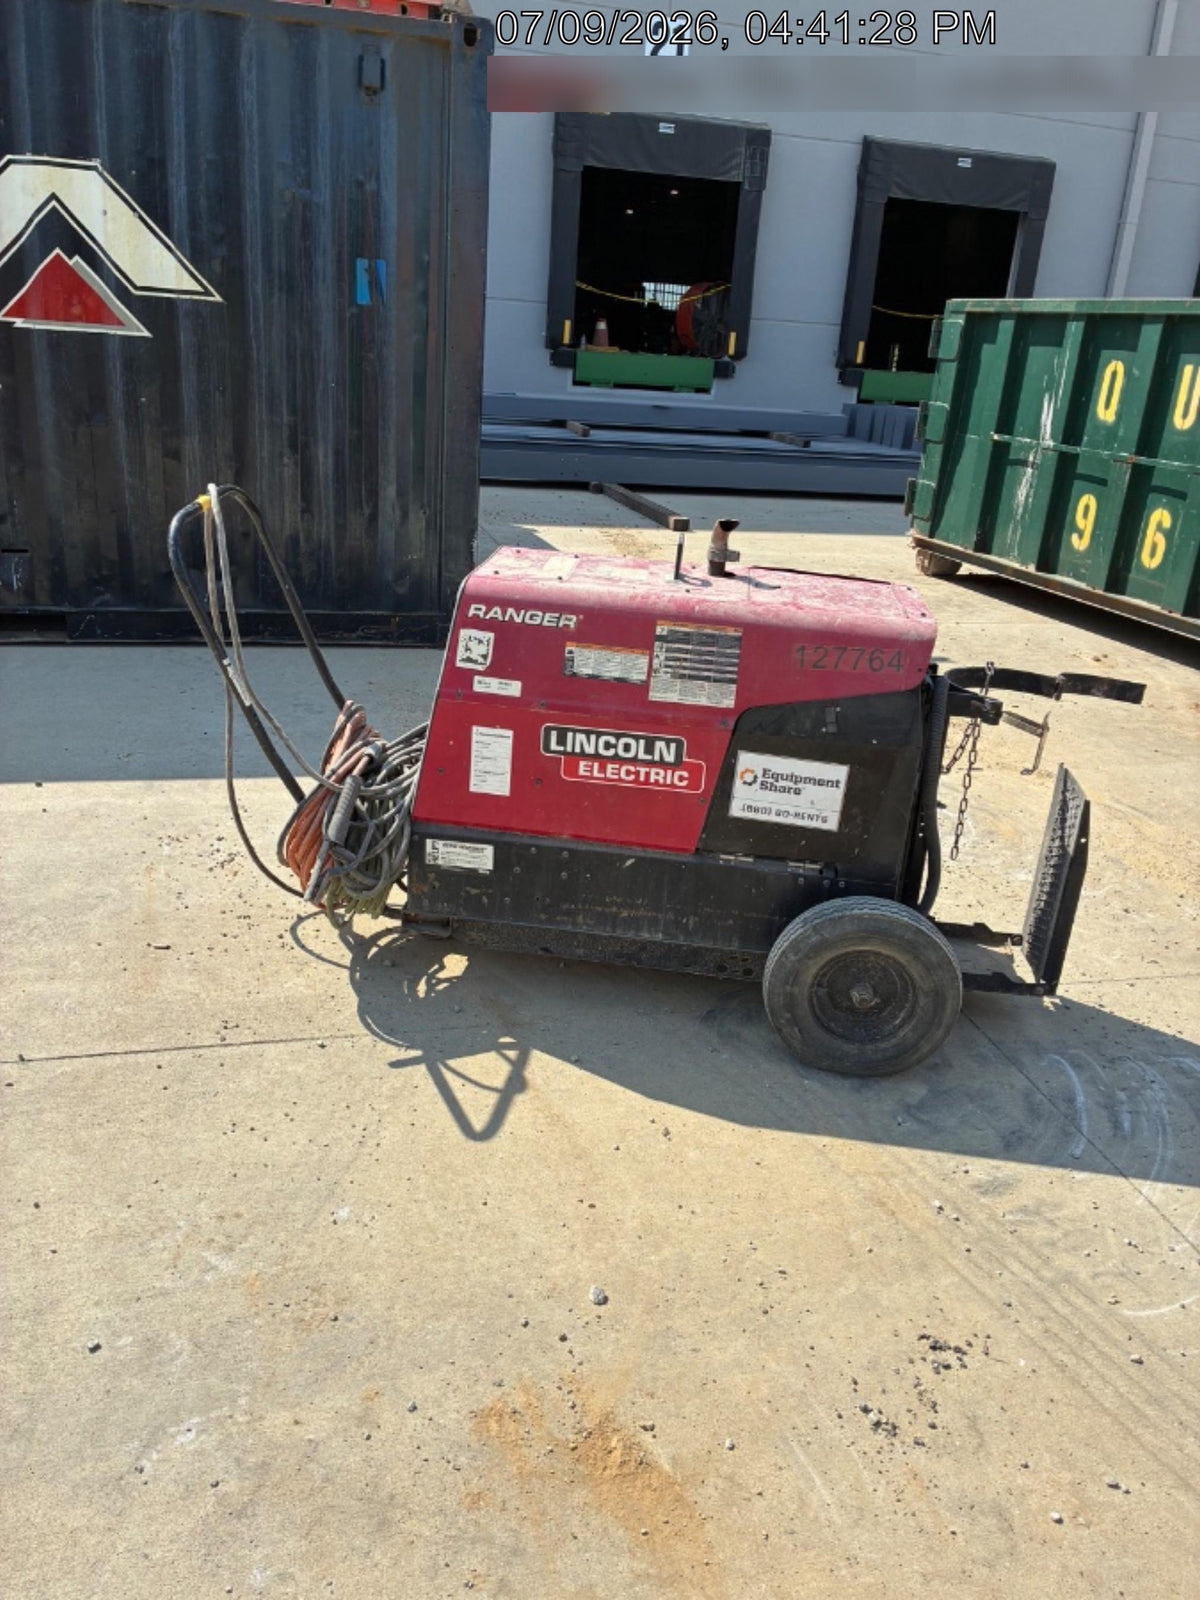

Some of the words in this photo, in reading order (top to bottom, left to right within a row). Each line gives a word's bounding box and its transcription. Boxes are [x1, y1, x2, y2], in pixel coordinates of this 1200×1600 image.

[467, 603, 578, 630] RANGER
[794, 644, 905, 674] 127764
[548, 730, 678, 764] LINCOLN
[578, 760, 691, 788] ELECTRIC
[759, 779, 802, 795] Share
[761, 767, 841, 789] Equipment
